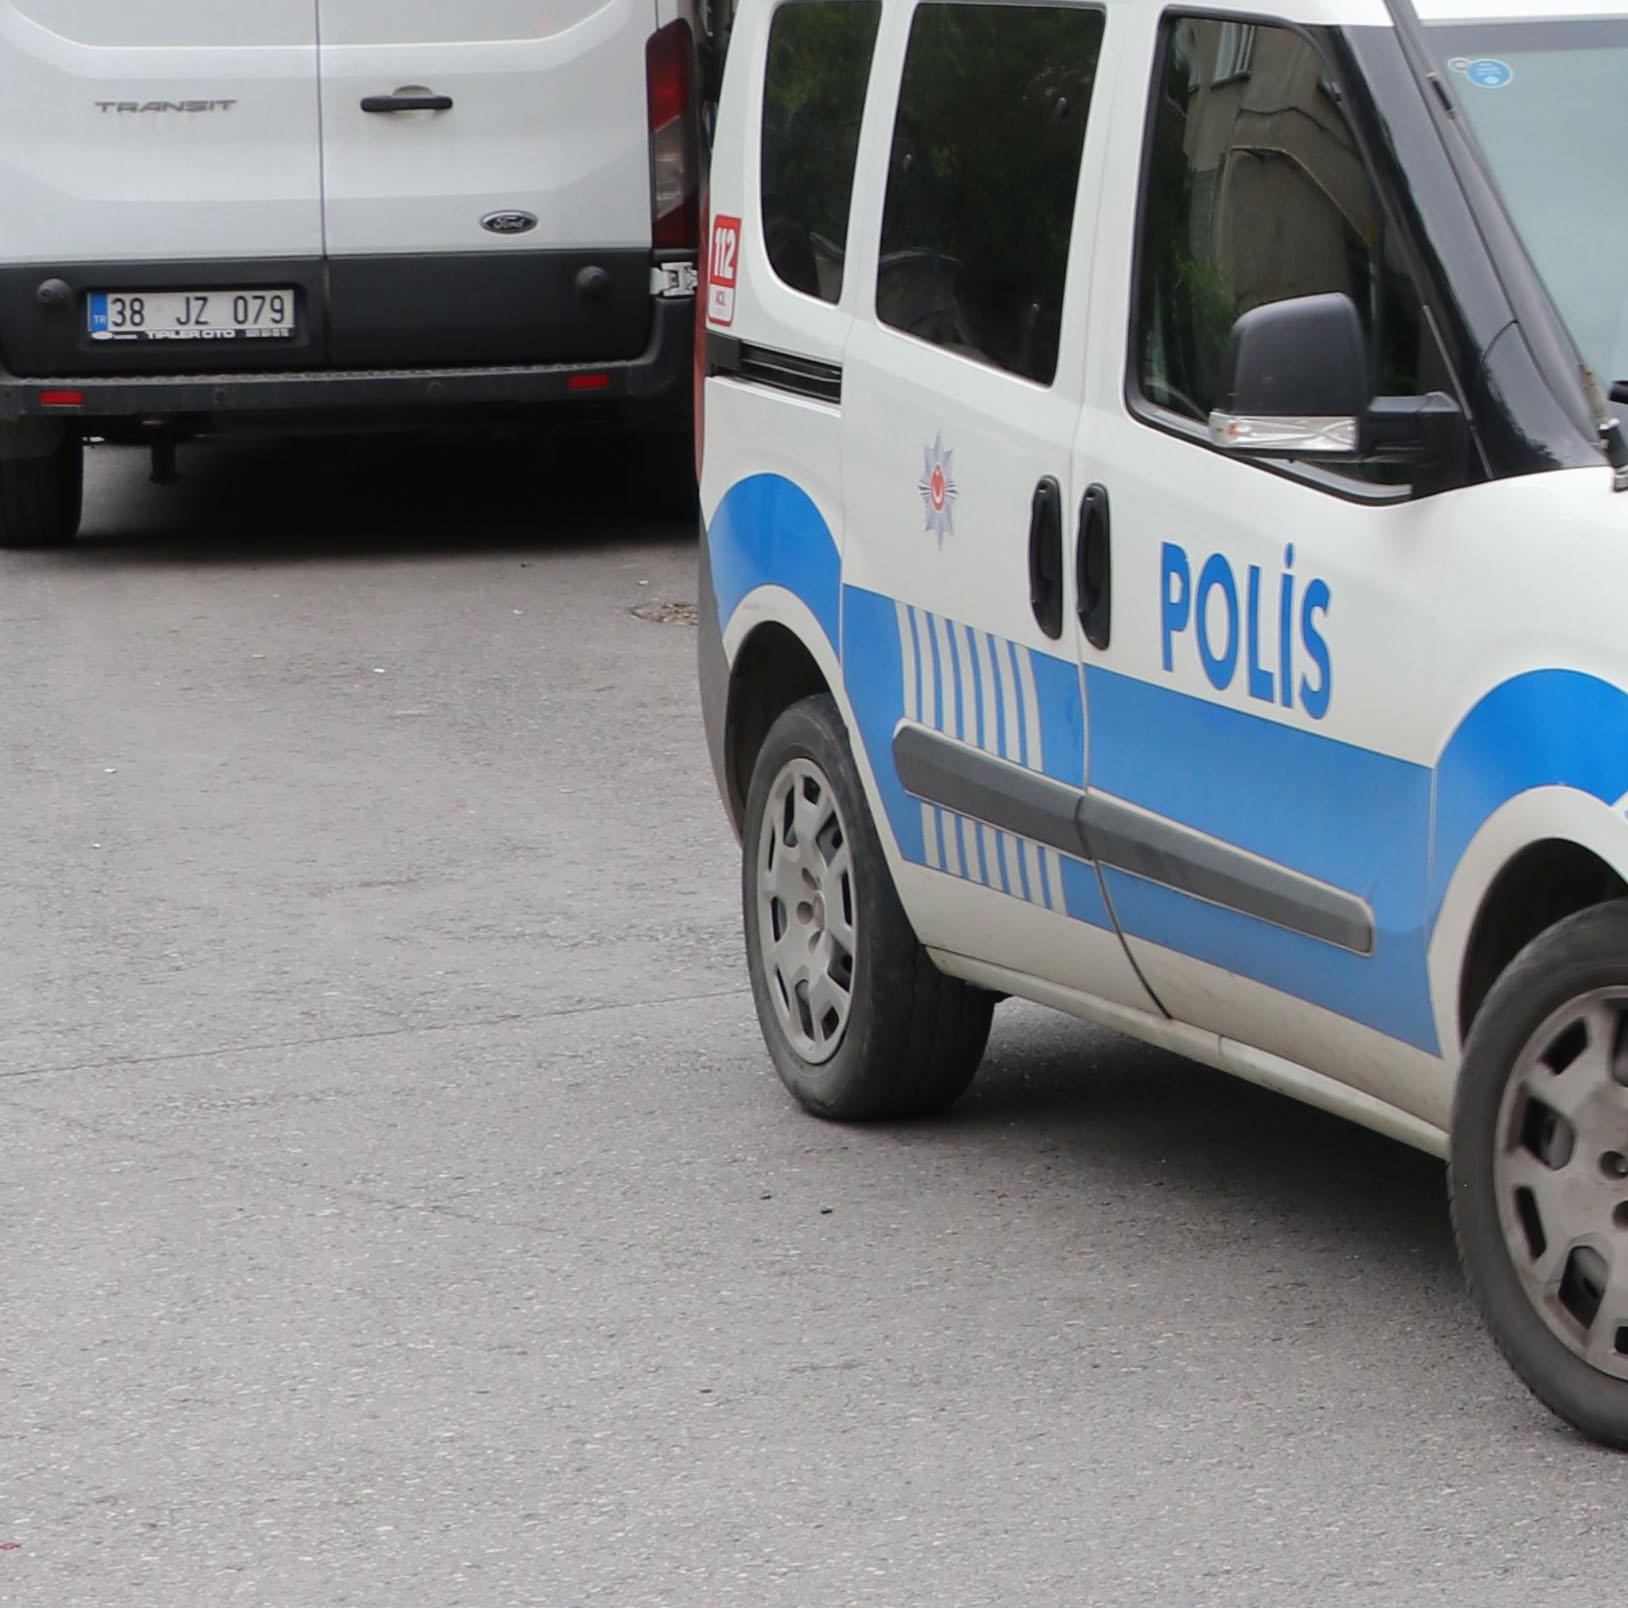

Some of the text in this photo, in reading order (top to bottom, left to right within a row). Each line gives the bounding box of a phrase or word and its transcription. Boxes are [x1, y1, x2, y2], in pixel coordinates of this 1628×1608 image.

[95, 100, 237, 113] TRANSIT
[714, 227, 736, 280] 112
[111, 295, 286, 328] 38 JZ 079
[1161, 542, 1333, 720] POLİS
